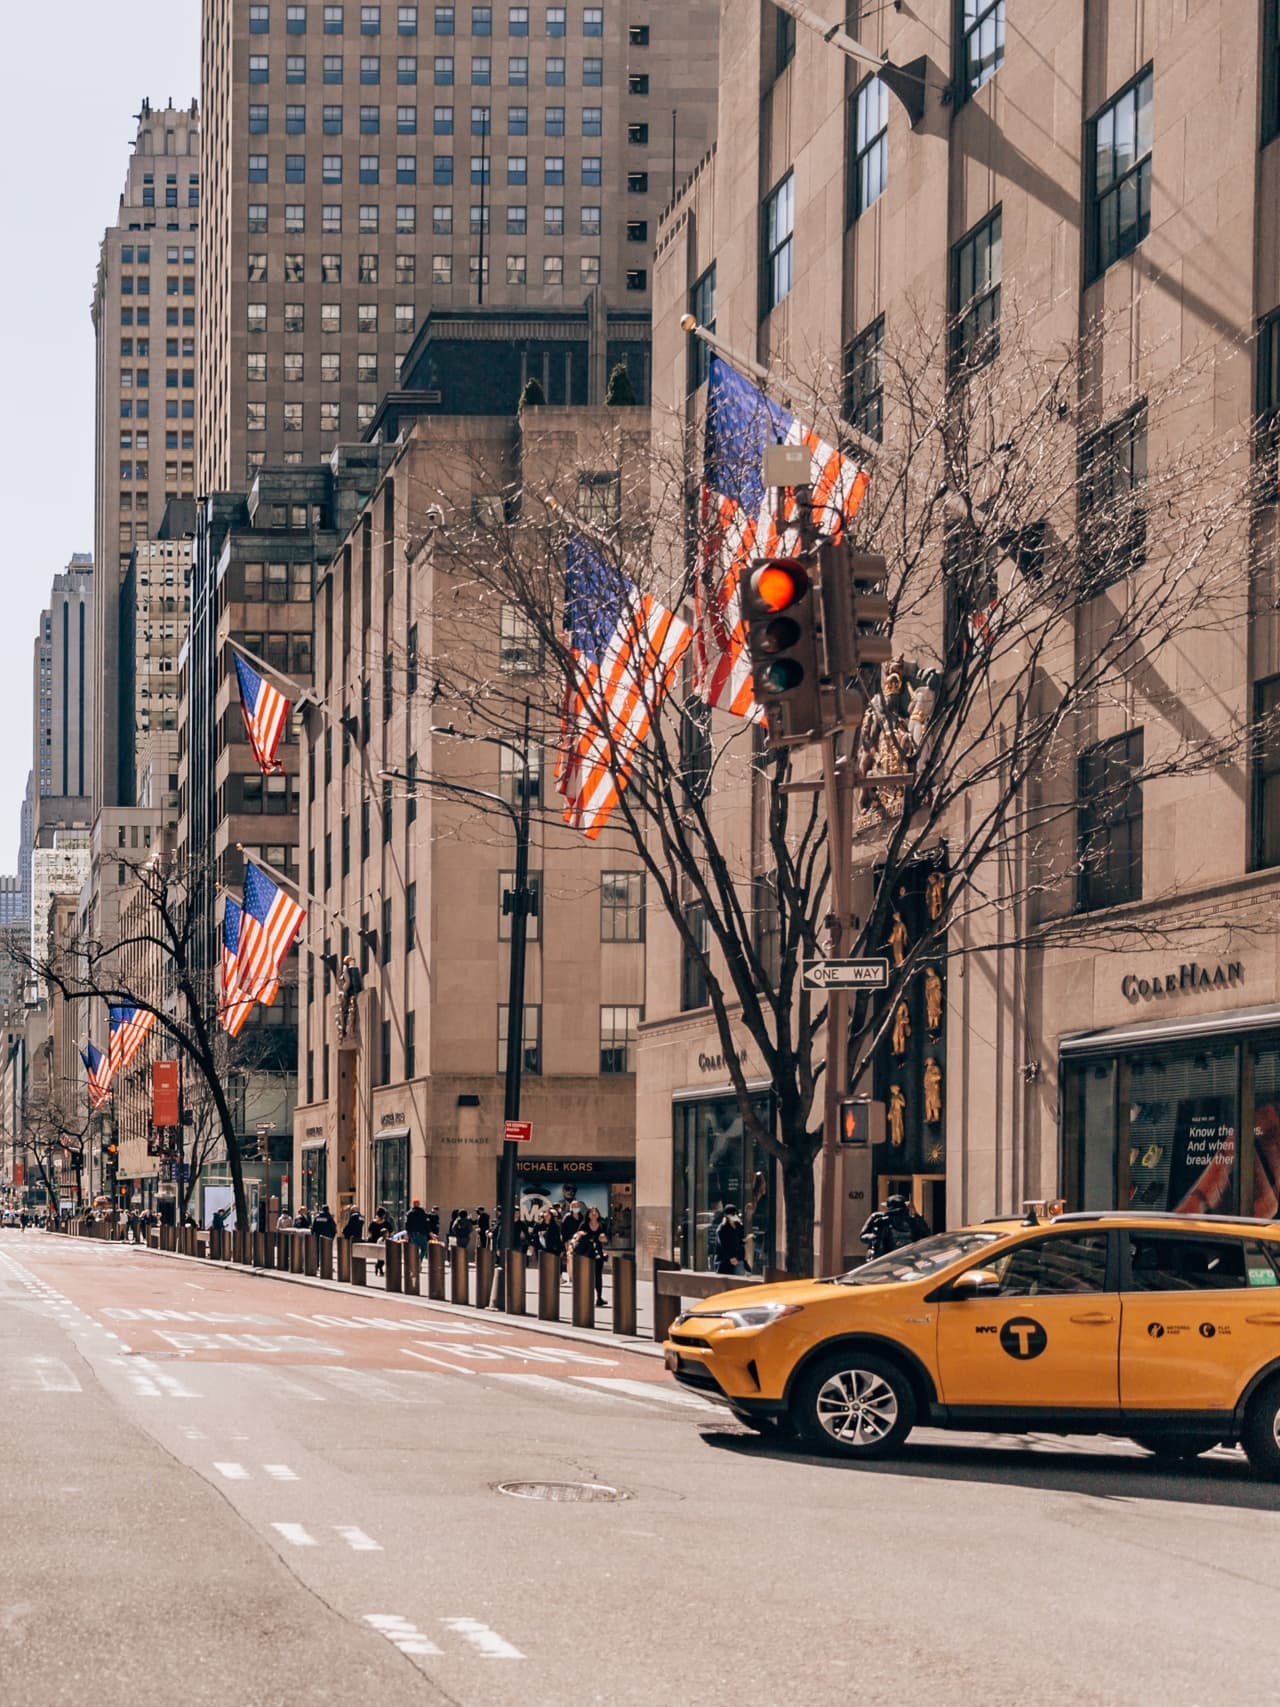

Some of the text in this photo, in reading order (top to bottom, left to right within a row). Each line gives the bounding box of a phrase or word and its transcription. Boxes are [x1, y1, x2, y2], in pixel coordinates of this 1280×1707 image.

[813, 968, 880, 980] ONE WAY
[1189, 1124, 1234, 1137] Know the
[1187, 1139, 1234, 1151] And when
[1186, 1154, 1212, 1165] break
[563, 1162, 593, 1172] KORS
[848, 1191, 864, 1199] 620
[1010, 1325, 1036, 1355] T
